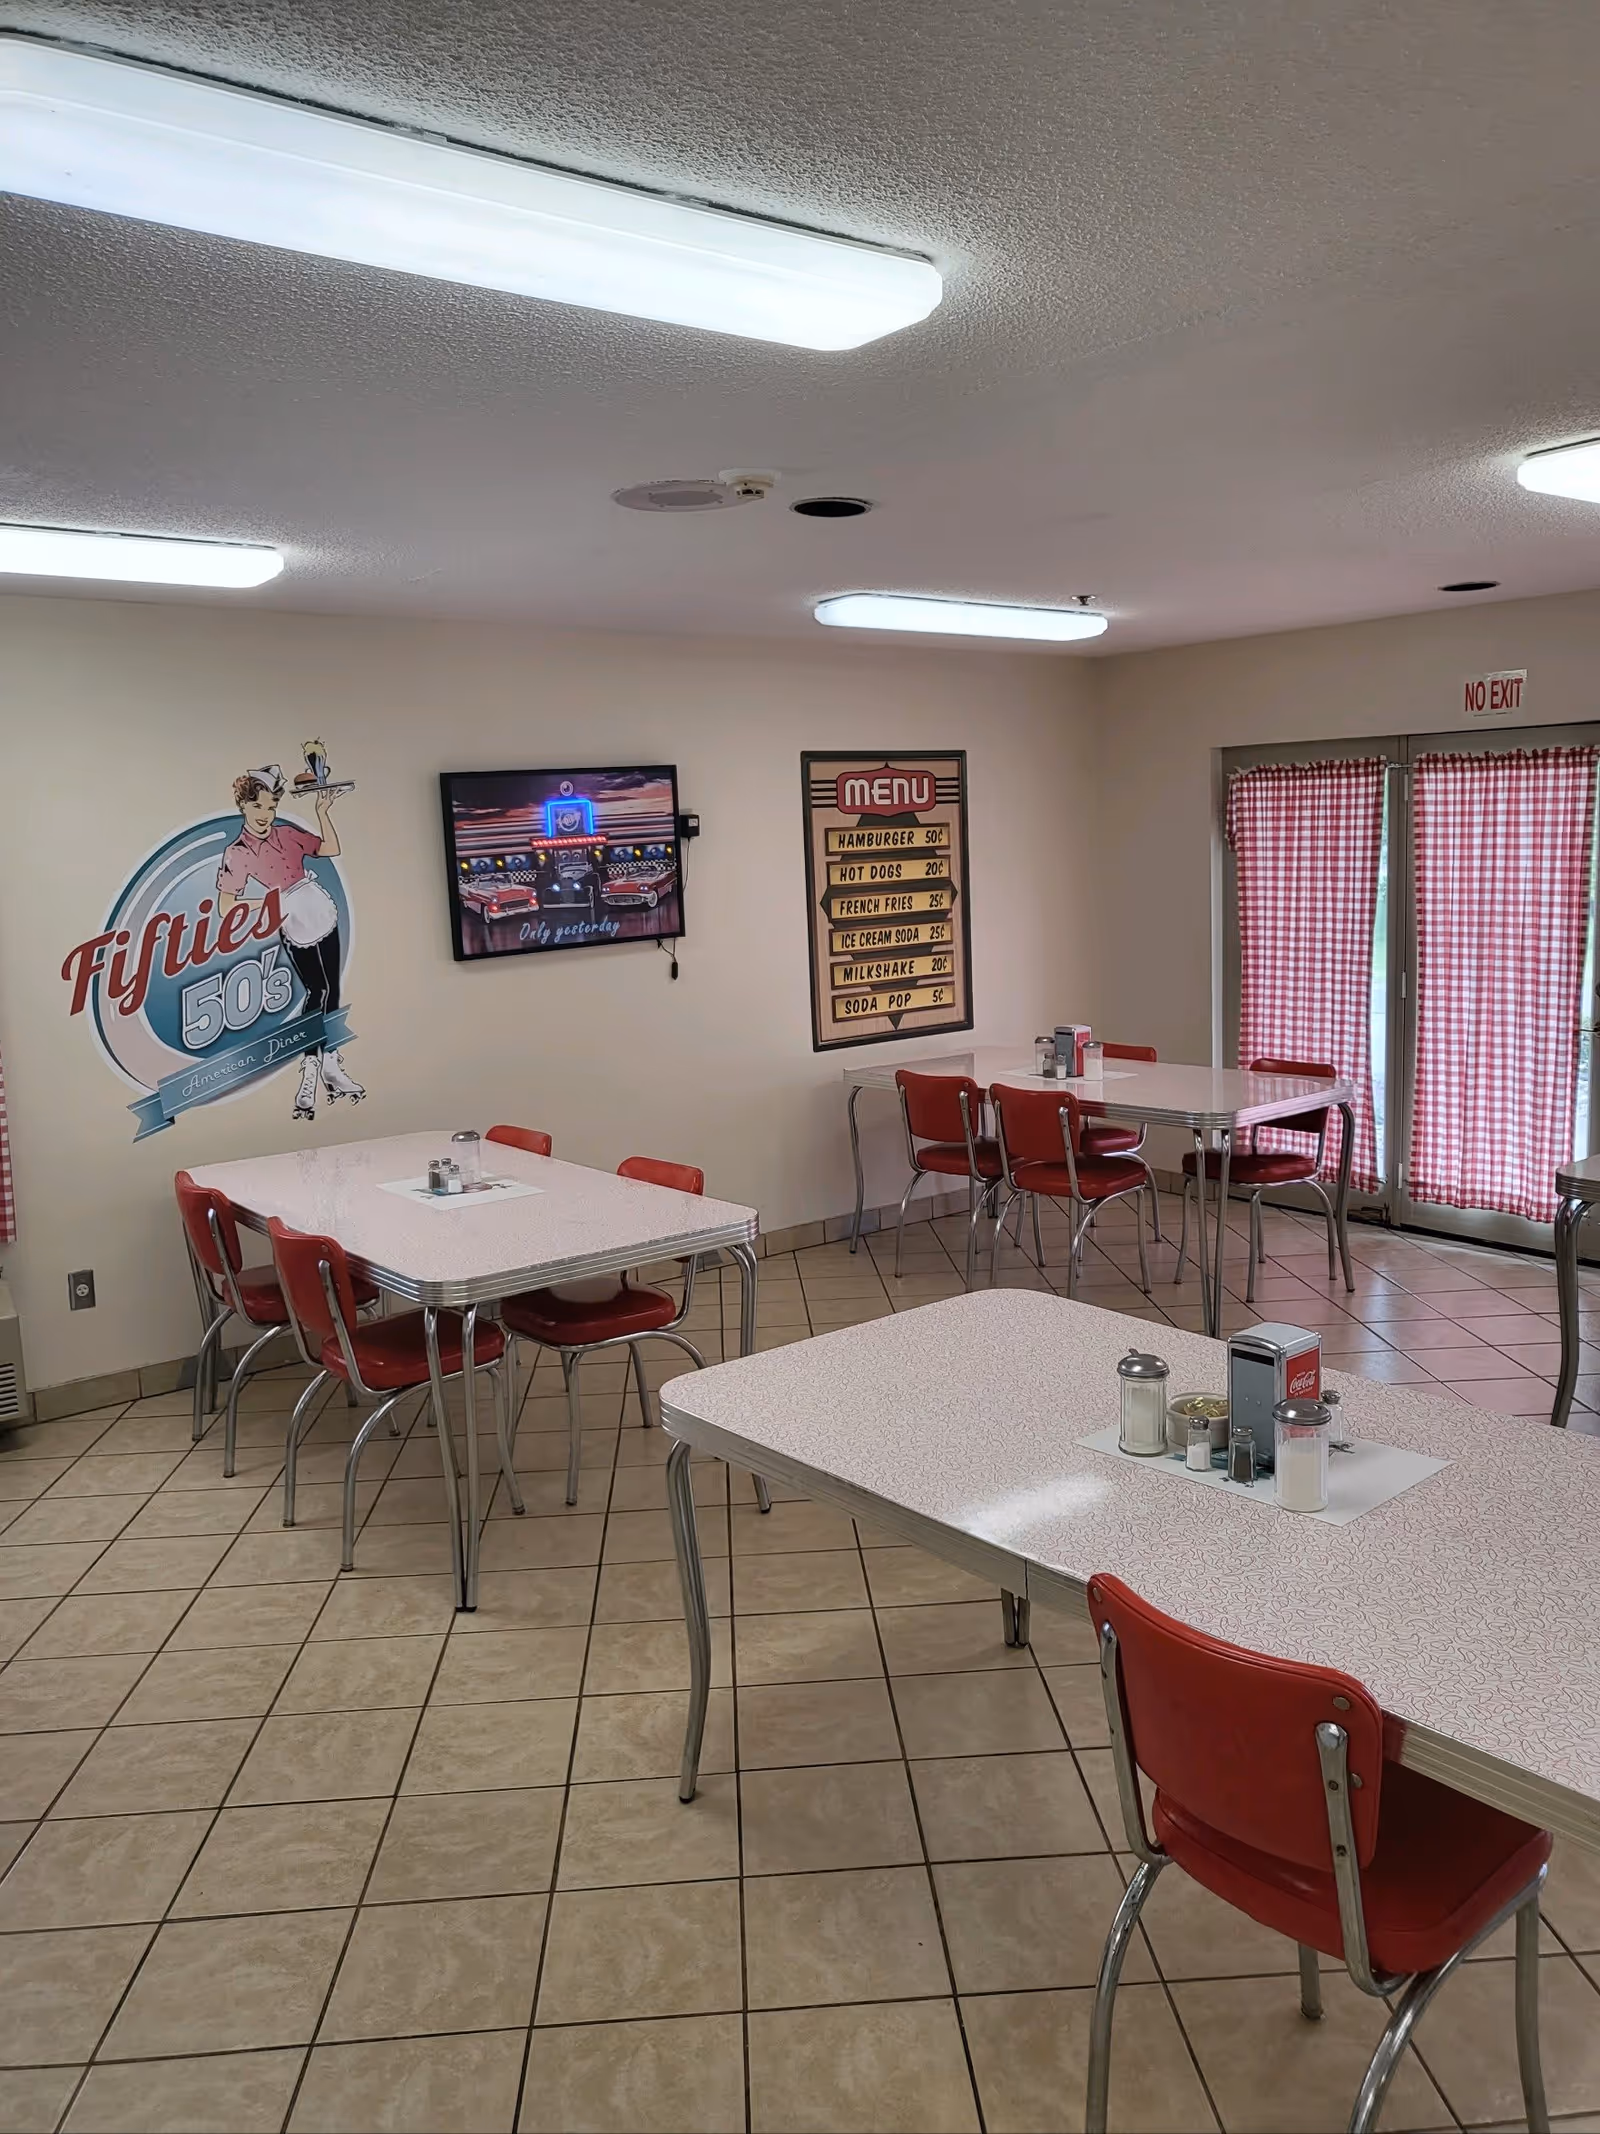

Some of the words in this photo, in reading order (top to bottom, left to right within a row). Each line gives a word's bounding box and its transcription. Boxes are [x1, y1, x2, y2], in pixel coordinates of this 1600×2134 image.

[1465, 680, 1486, 712] NO
[1491, 677, 1523, 710] EXIT
[844, 777, 929, 806] MENU
[838, 830, 915, 849] HAMBURGER
[925, 828, 943, 844] 50¢
[840, 865, 864, 881] HOT
[870, 863, 902, 879] DOGS
[925, 861, 943, 876] 20¢
[840, 898, 880, 915] FRENCH
[885, 895, 913, 912] FRIES
[929, 892, 943, 908] 25¢
[520, 921, 551, 944] Only
[554, 914, 620, 943] yesterday
[841, 933, 856, 949] ICE
[859, 930, 892, 947] CREAM
[895, 927, 919, 943] SODA
[929, 924, 945, 940] 25¢
[61, 887, 288, 1016] Fifties
[843, 960, 915, 982] MILKSHAKE
[931, 957, 947, 972] 20¢
[182, 945, 292, 1050] 50's
[845, 997, 878, 1015] SODA
[888, 992, 912, 1008] POP
[932, 989, 944, 1003] 5¢
[182, 1055, 256, 1097] American
[264, 1030, 307, 1062] Diner
